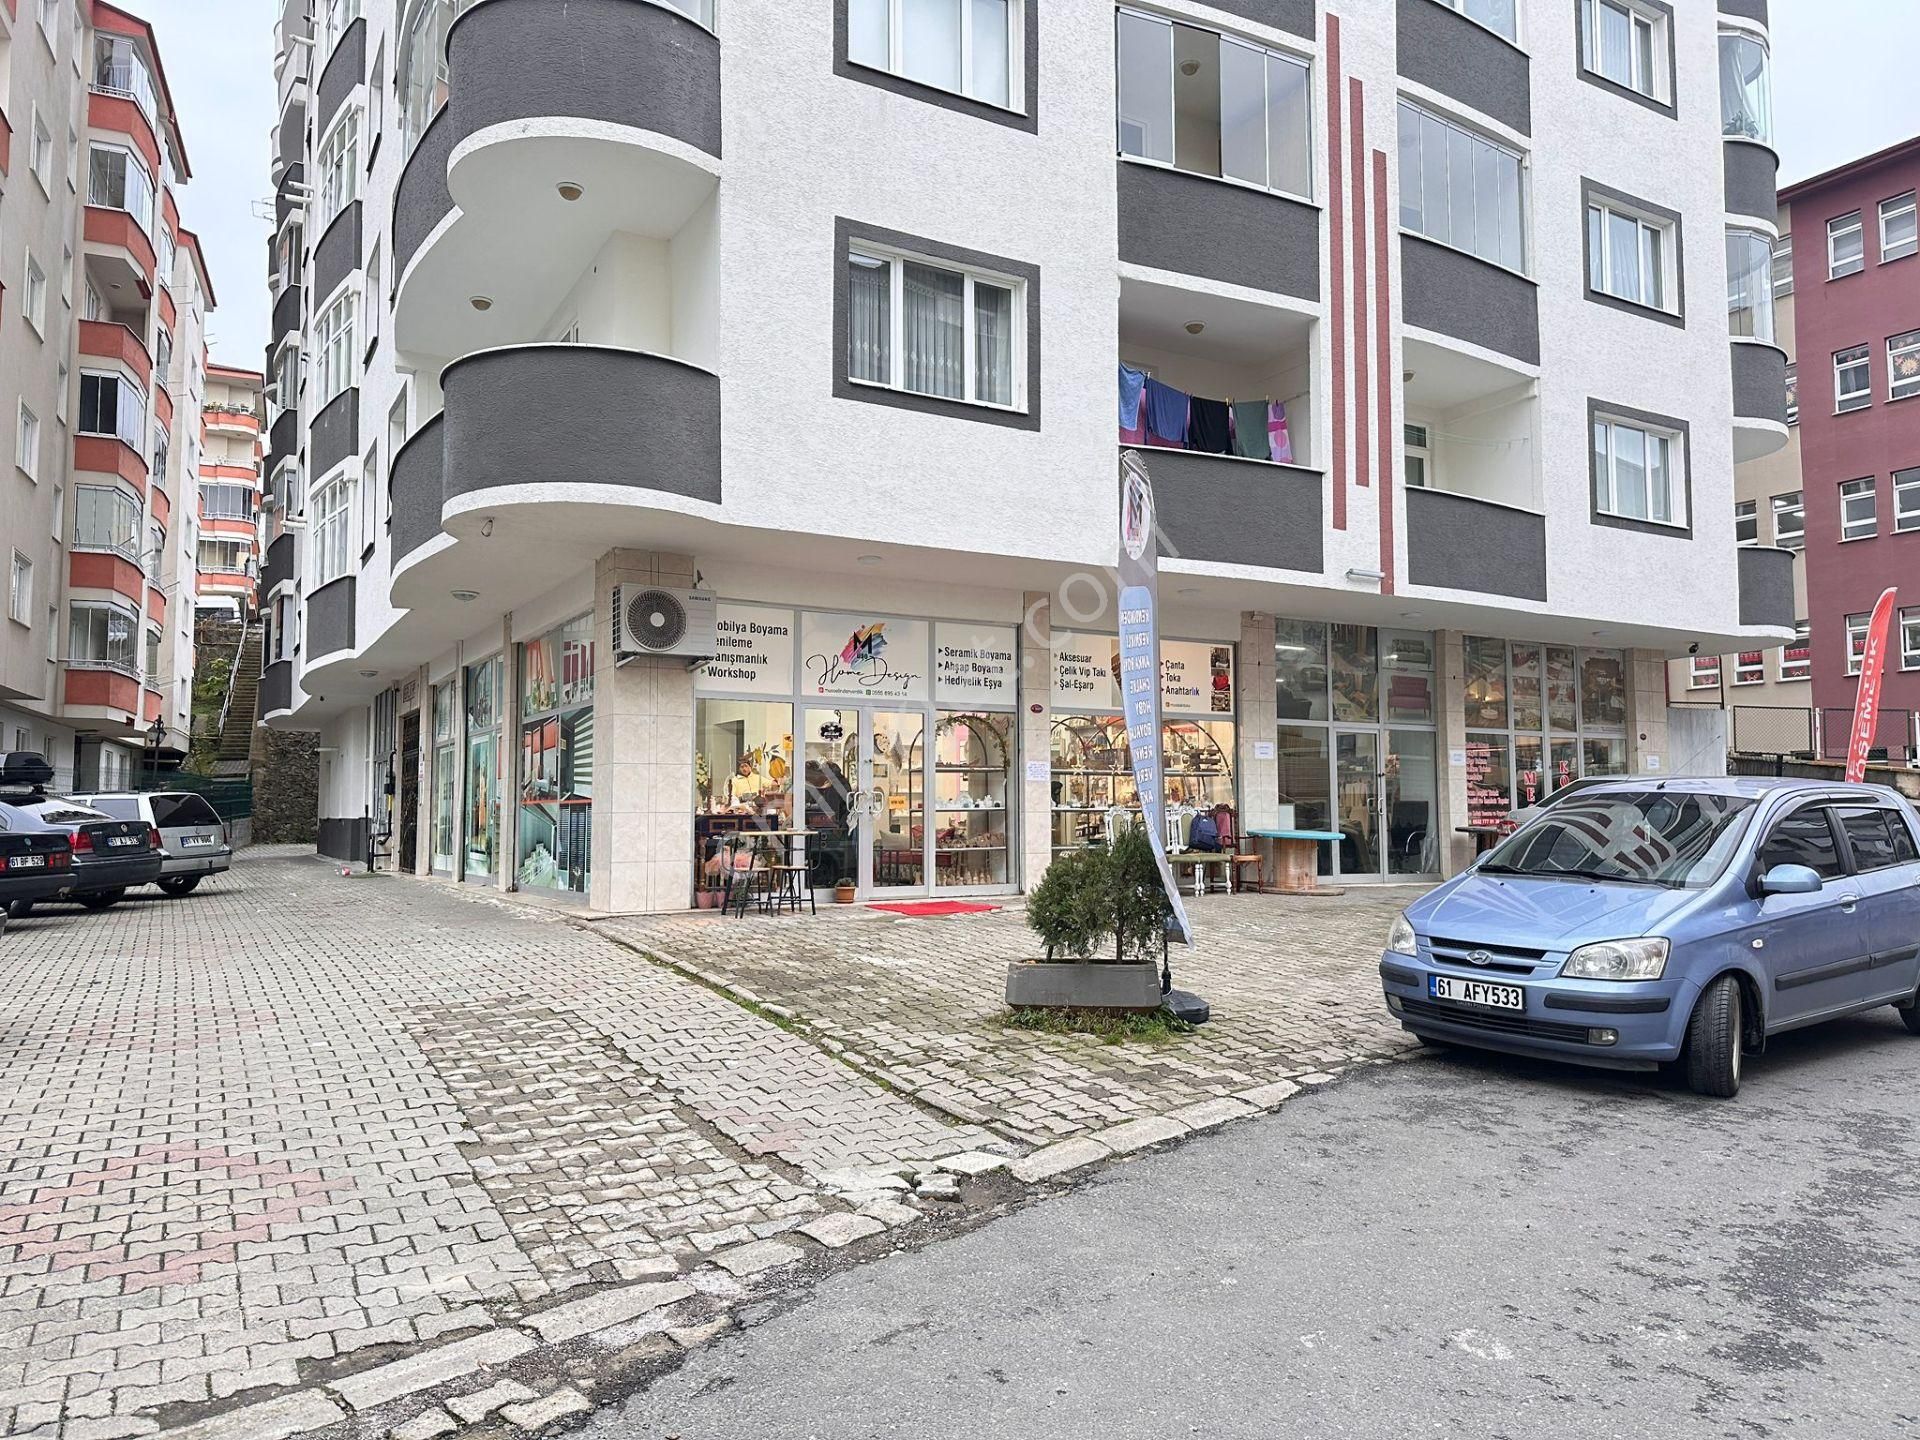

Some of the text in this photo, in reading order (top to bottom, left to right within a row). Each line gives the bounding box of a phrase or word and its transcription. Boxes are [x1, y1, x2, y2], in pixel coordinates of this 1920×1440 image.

[717, 621, 788, 637] obilya Boyama
[715, 652, 768, 666] anışmanlık
[944, 646, 1012, 661] Seramik Boyama
[1058, 651, 1092, 664] Aksesuar
[806, 653, 922, 690] Home Design
[944, 660, 1004, 675] Ahşap Boyama
[1059, 666, 1107, 678] Çelik Vip Takı
[1165, 659, 1185, 671] Çanta
[707, 666, 757, 682] Workshop
[1165, 672, 1182, 683] Toka
[944, 675, 1003, 690] Hediyelik Eşya
[1059, 678, 1095, 692] Şal-Eşarp
[1165, 685, 1200, 697] Anahtarlık
[11, 857, 19, 867] 61
[1437, 978, 1520, 1008] 61 AFY533
